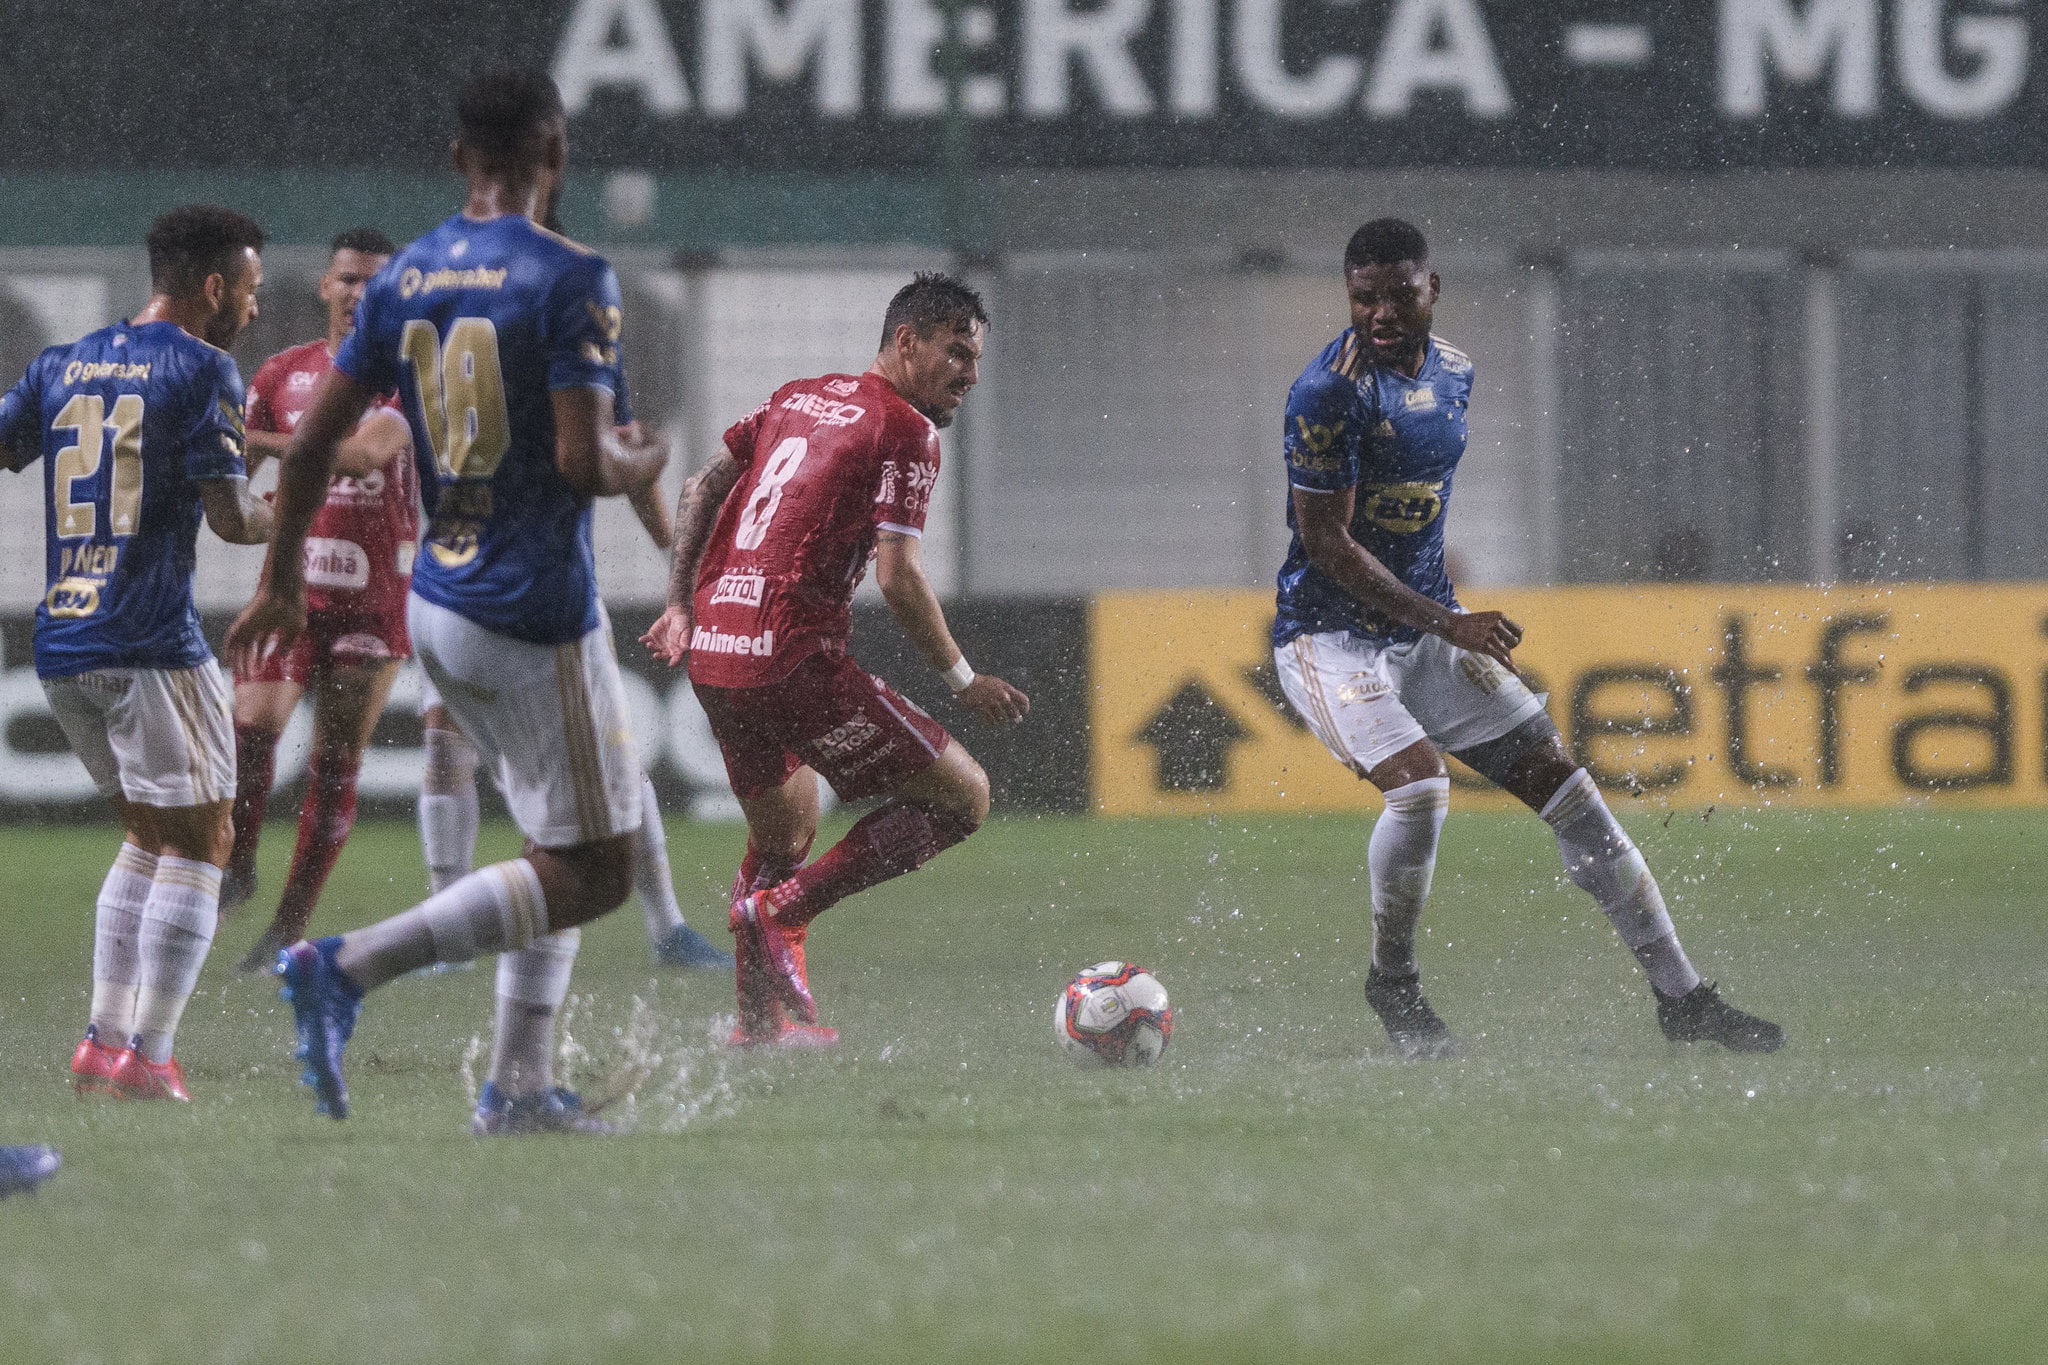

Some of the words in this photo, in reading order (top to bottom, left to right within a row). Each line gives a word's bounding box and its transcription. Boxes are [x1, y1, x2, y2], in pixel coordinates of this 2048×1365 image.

[1718, 0, 2031, 119] MG
[400, 317, 511, 476] 18
[51, 394, 145, 538] 21
[735, 436, 808, 551] 8
[690, 625, 774, 657] Unimed
